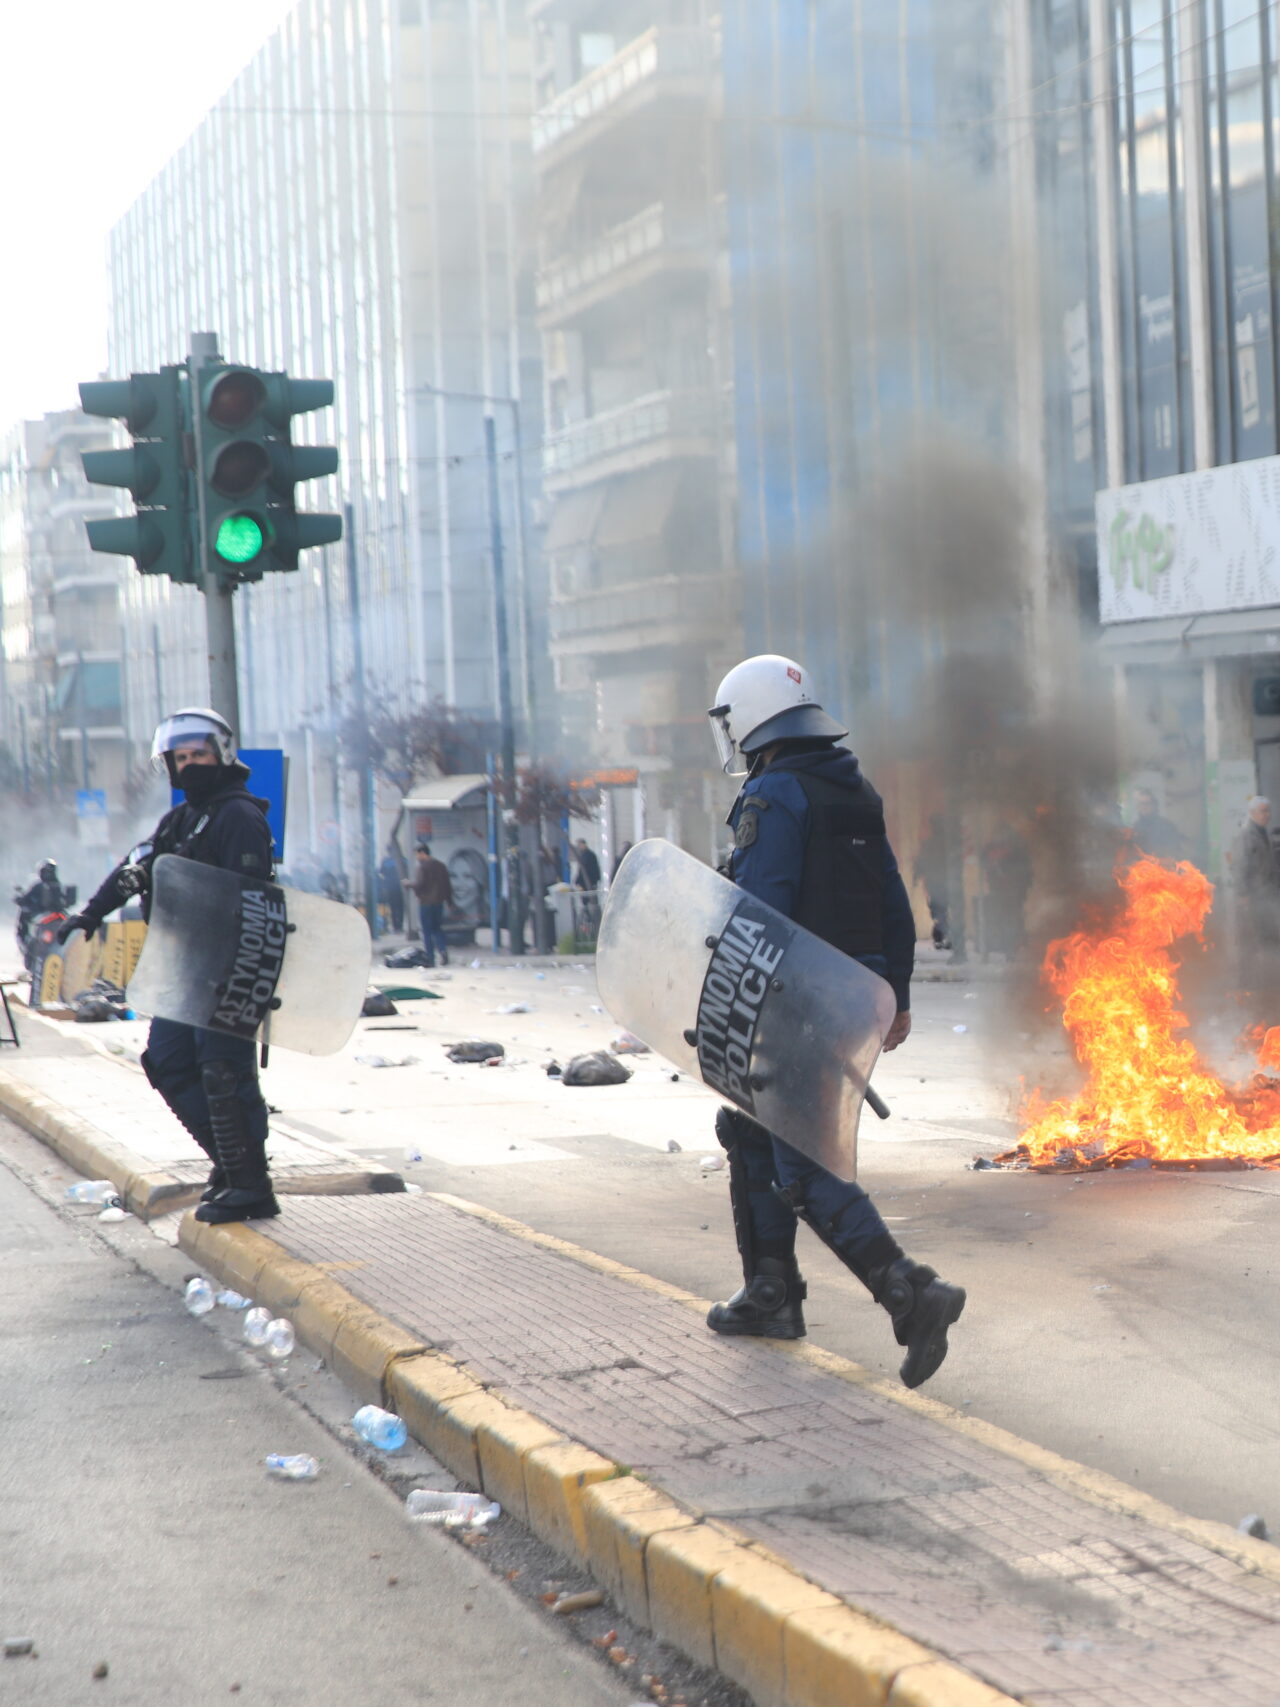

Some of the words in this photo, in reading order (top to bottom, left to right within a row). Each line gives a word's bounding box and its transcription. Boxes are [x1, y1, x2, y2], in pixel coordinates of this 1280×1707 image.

[215, 890, 266, 1026] ΑΣΤΥΝΟΜΙΑ
[240, 899, 286, 1026] POLICE
[698, 915, 766, 1094] ΑΣΤΥΝΟΜΙΑ
[724, 936, 785, 1101] POLICE
